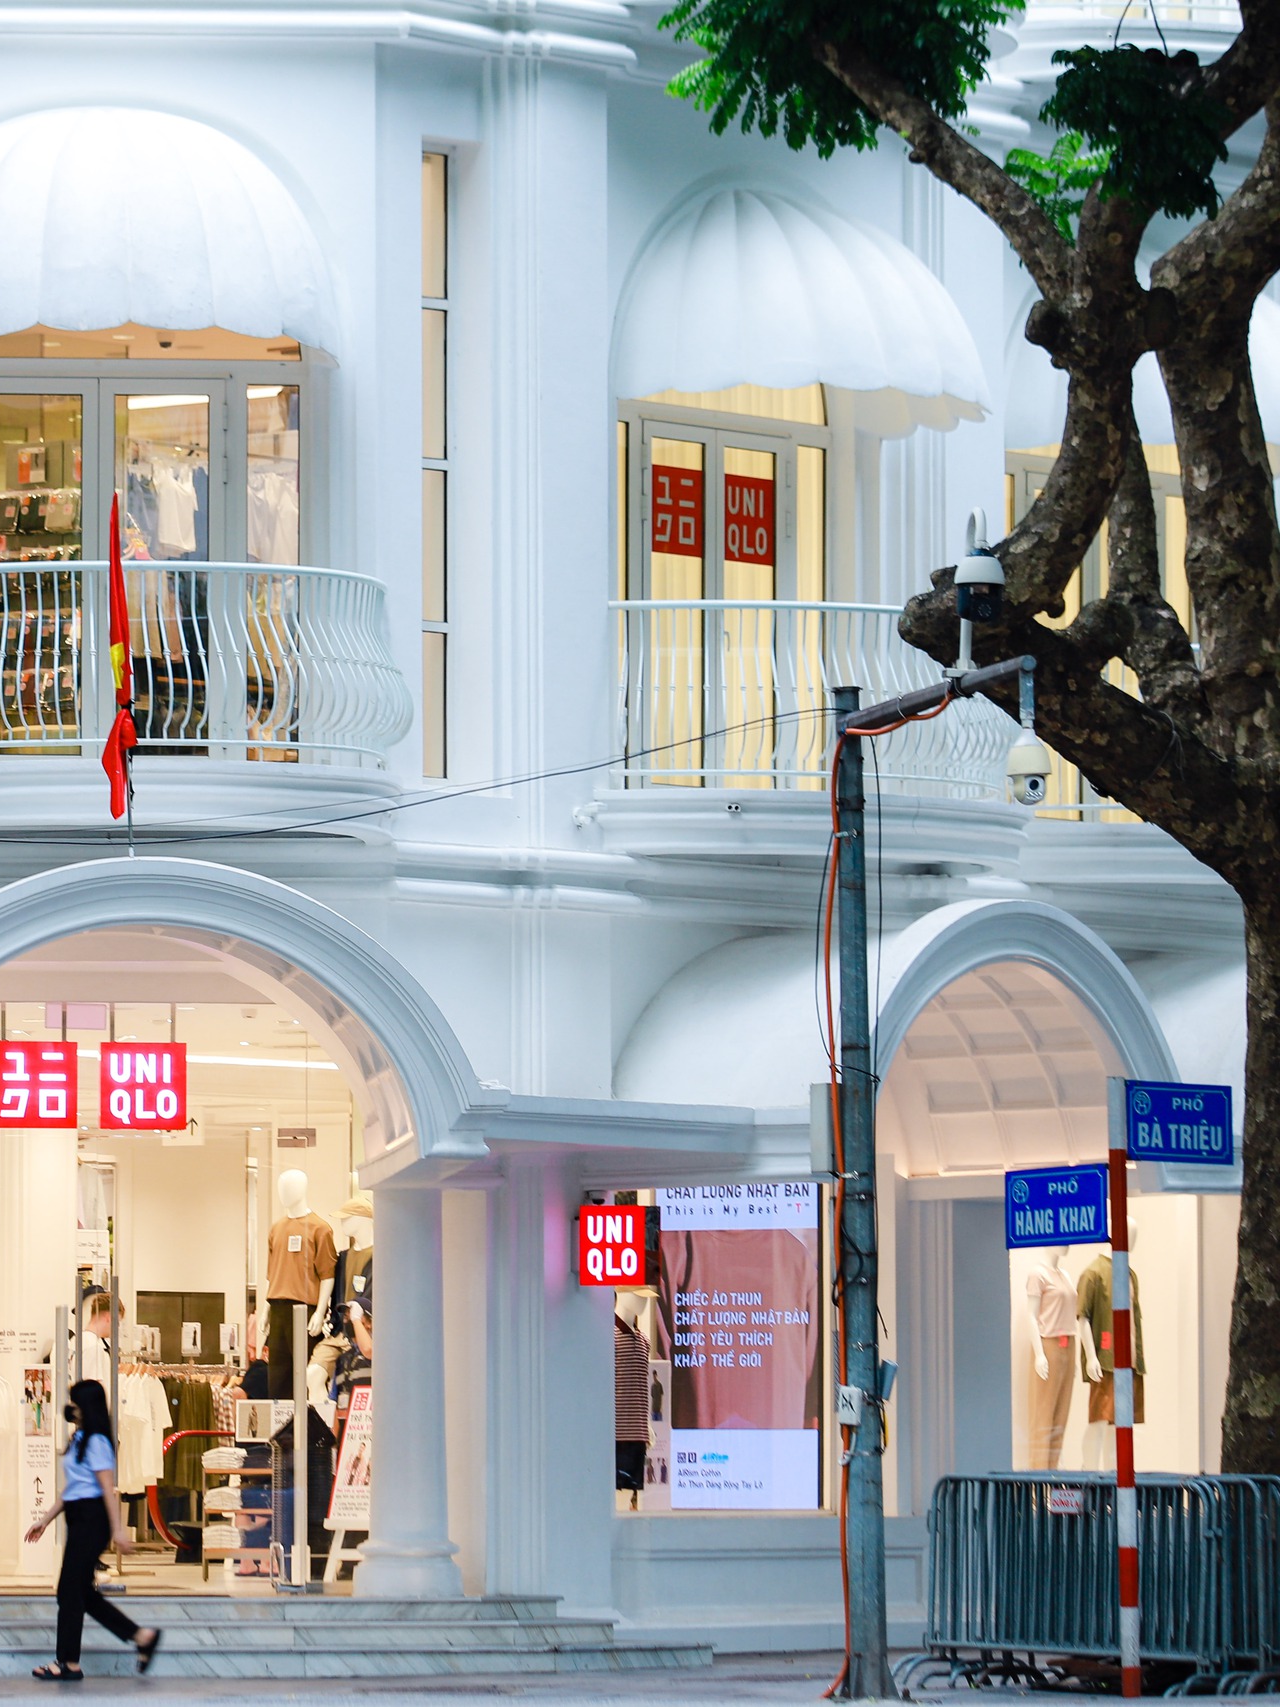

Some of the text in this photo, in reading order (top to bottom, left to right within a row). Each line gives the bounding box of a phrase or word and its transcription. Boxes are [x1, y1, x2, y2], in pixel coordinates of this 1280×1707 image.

[728, 486, 764, 519] UNI
[728, 523, 767, 558] QLO
[110, 1053, 171, 1083] UNI
[110, 1089, 177, 1124] QLO
[1172, 1093, 1205, 1112] PHỐ
[1138, 1117, 1222, 1156] BÀ TRIỆU
[1048, 1176, 1078, 1195] PHỐ
[666, 1206, 694, 1215] This
[703, 1206, 713, 1214] is
[724, 1205, 738, 1216] My
[749, 1204, 778, 1214] Best
[1015, 1206, 1096, 1236] HÀNG KHAY
[587, 1215, 633, 1244] UNI
[586, 1249, 638, 1281] QLO
[674, 1288, 708, 1306] CHIẾC
[730, 1292, 762, 1306] THUN
[674, 1308, 706, 1326] CHẤT
[751, 1309, 782, 1328] NHẬT
[710, 1330, 733, 1346] YÊU
[738, 1330, 773, 1346] THÍCH
[674, 1347, 706, 1367] KHẮP
[711, 1349, 735, 1367] THẾ
